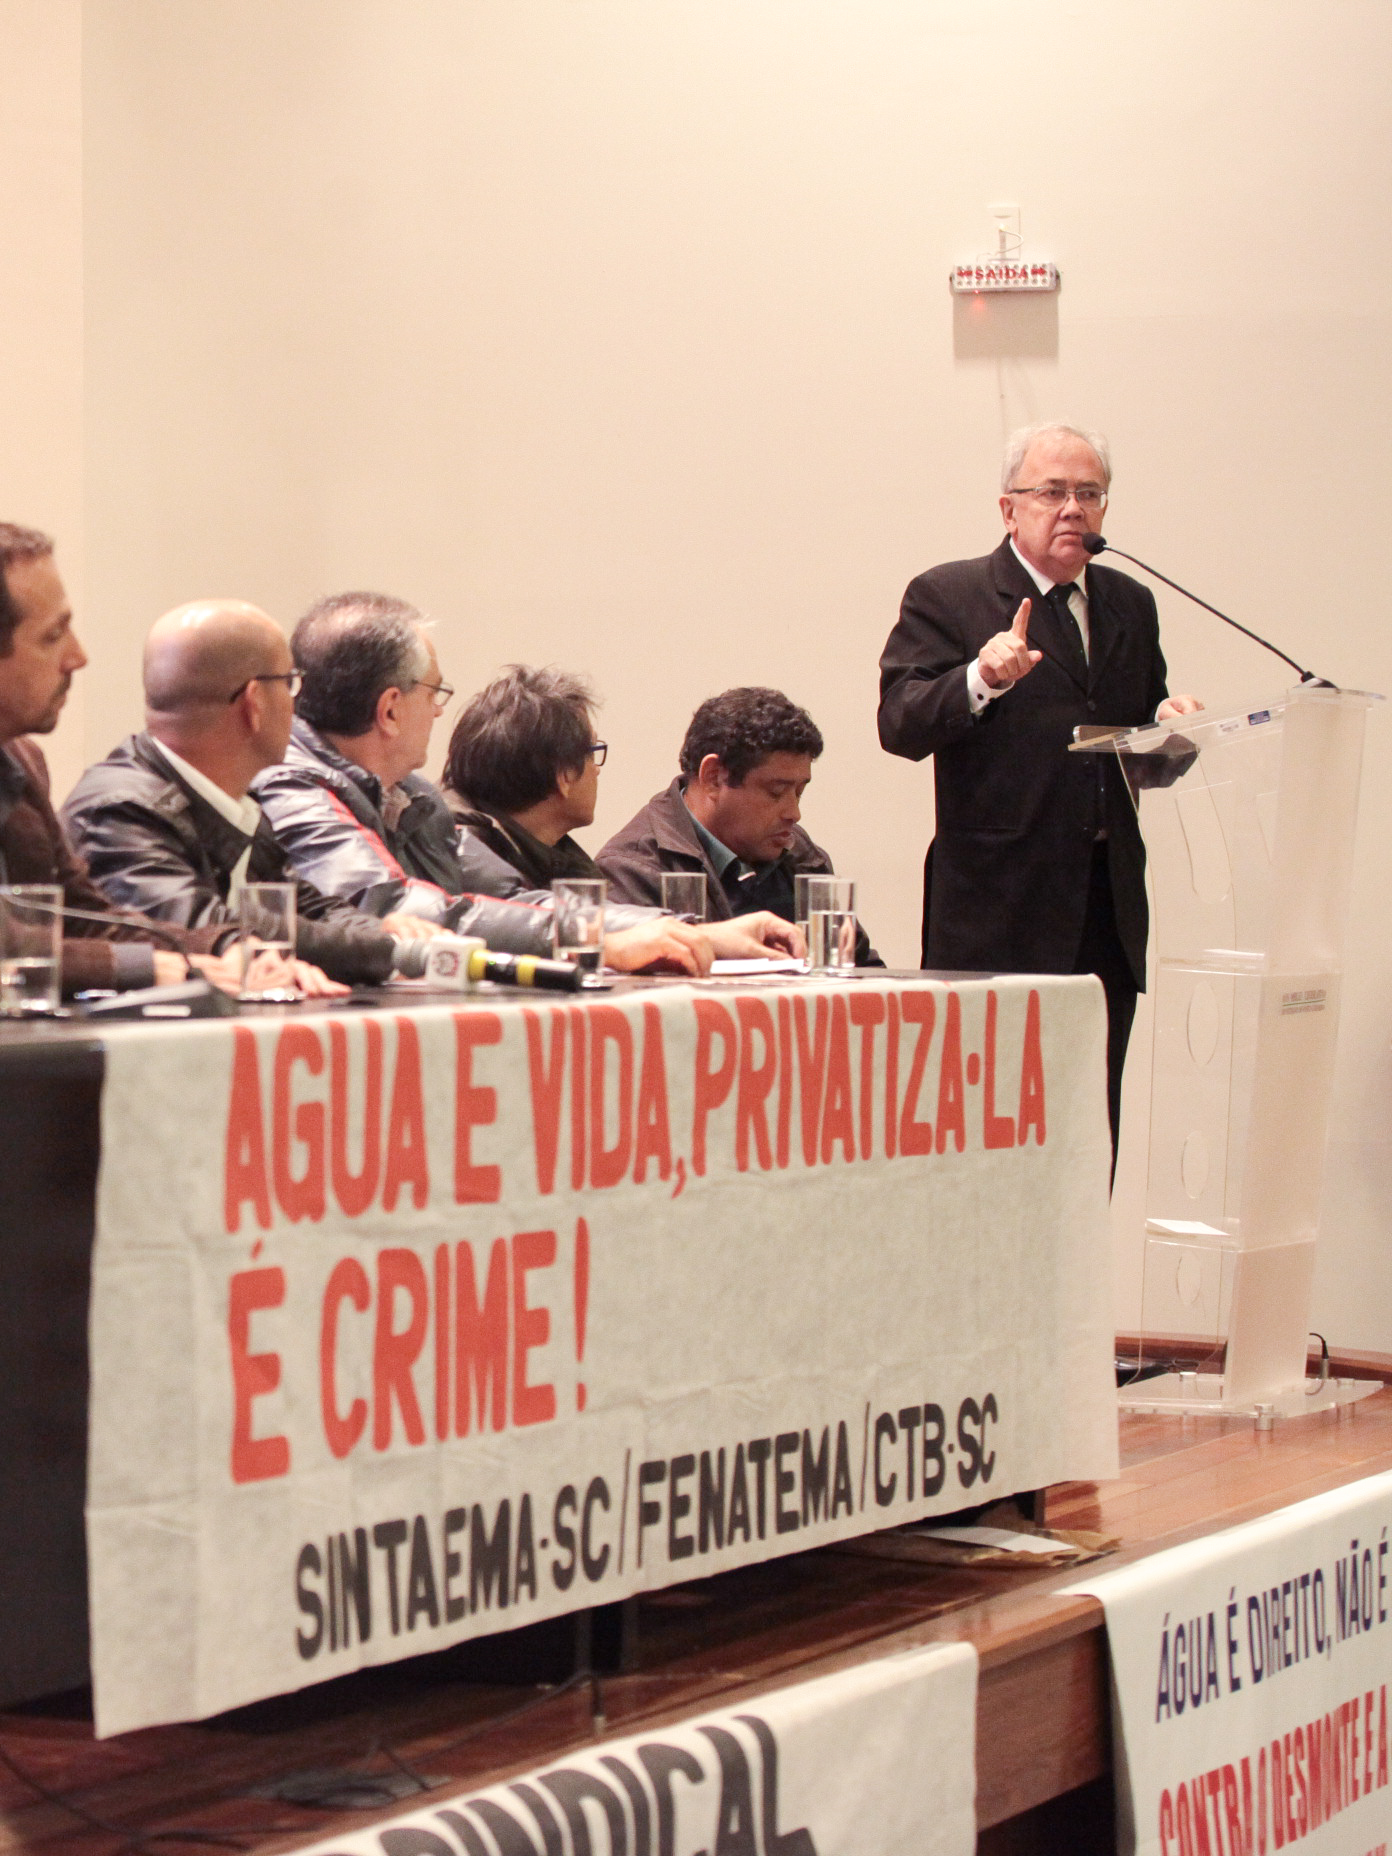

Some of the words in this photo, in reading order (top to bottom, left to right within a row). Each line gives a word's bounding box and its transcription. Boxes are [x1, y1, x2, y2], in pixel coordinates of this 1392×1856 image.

[523, 1001, 686, 1198] VIDA,
[227, 1239, 291, 1485] É
[320, 1216, 590, 1459] CRIME!
[1155, 1612, 1220, 1724] ÁGUA
[1226, 1586, 1241, 1694] É
[1246, 1568, 1332, 1684] DIREITO,
[1335, 1538, 1373, 1644] NÃO
[1377, 1525, 1388, 1625] É
